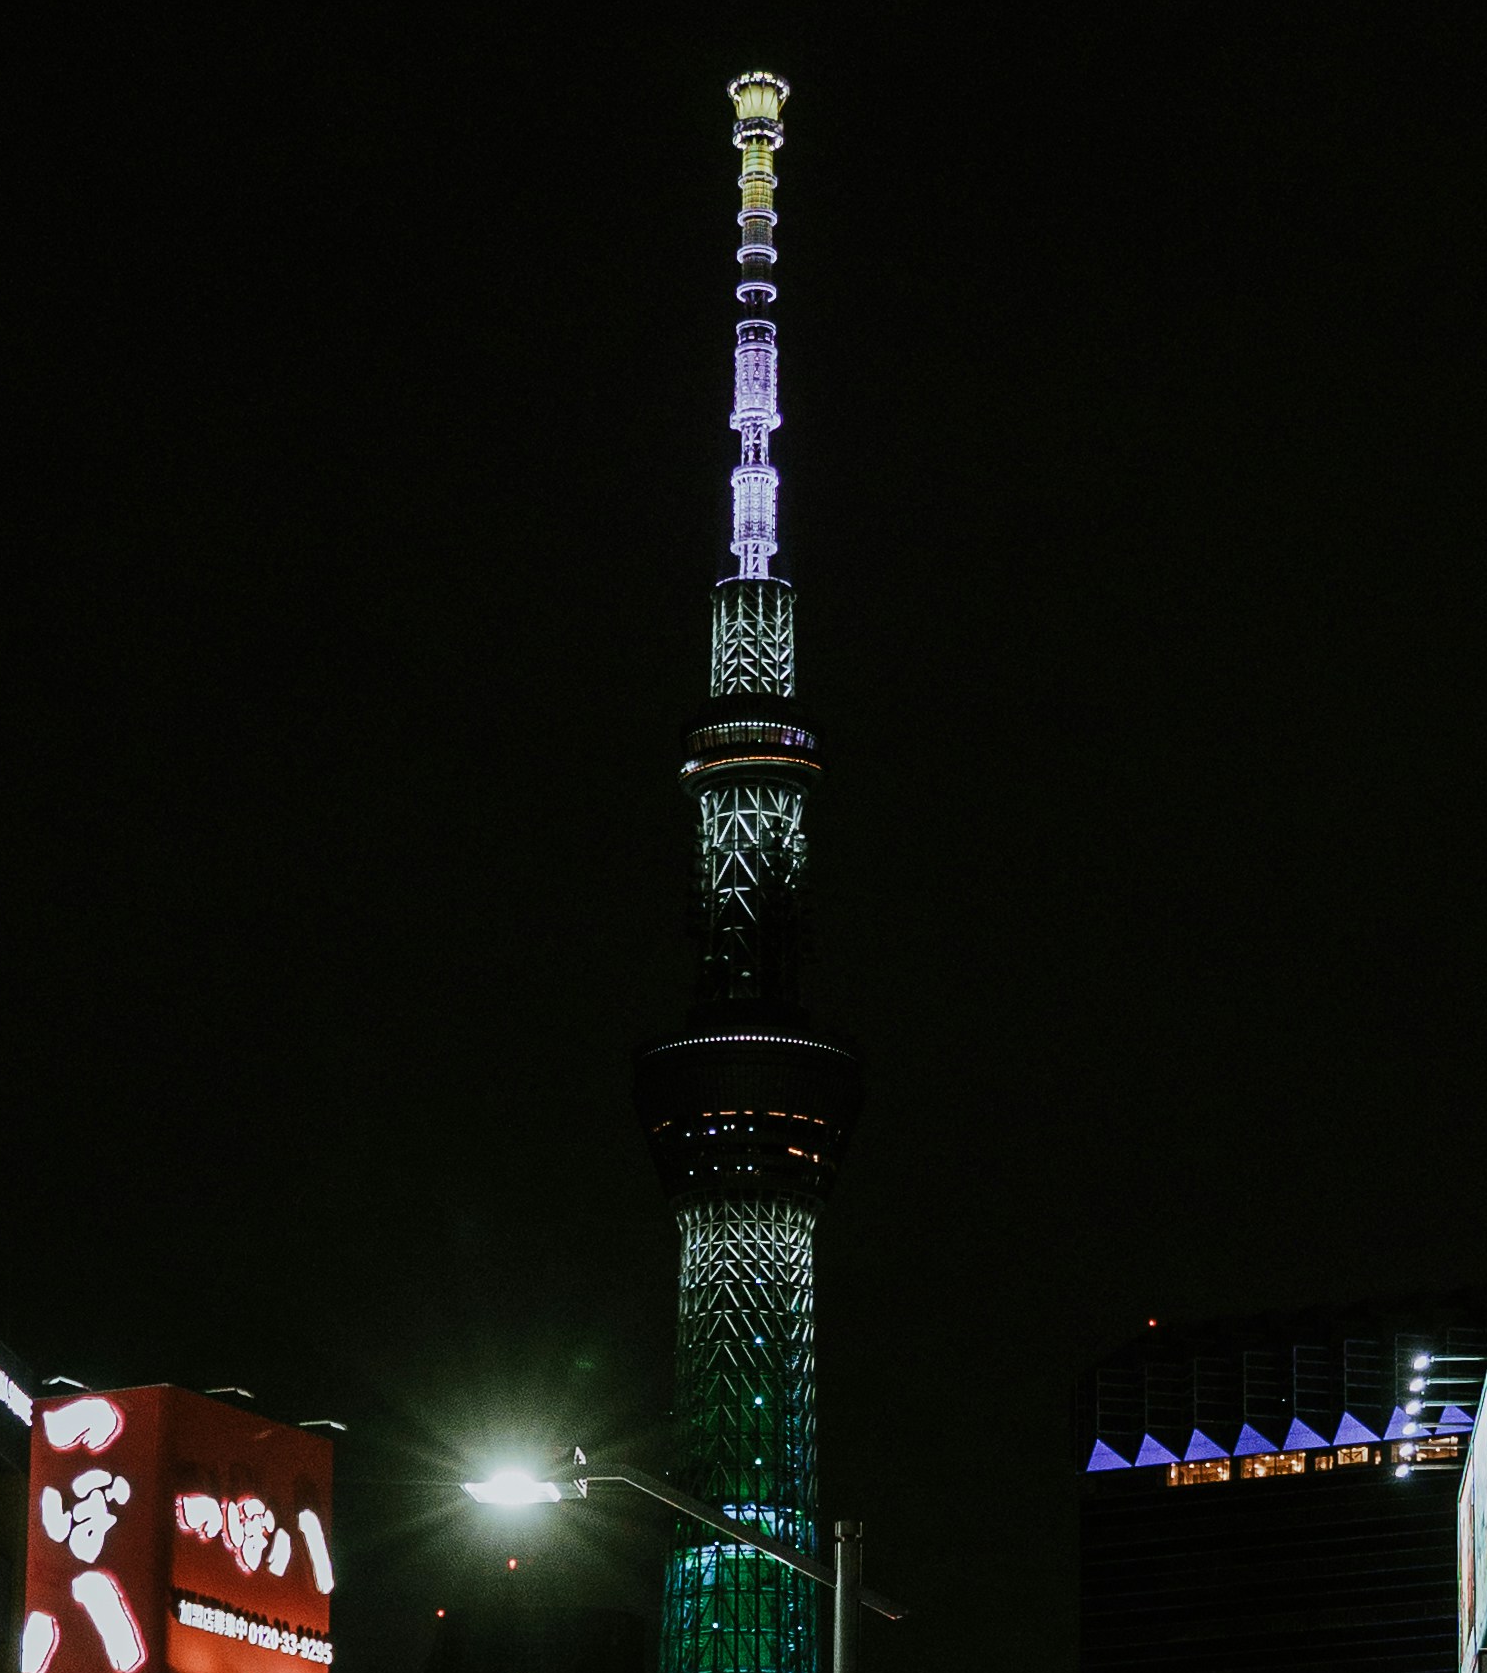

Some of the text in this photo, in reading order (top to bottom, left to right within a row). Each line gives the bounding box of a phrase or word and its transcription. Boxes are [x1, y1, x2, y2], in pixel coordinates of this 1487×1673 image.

[21, 1397, 147, 1673] つぼ八
[176, 1493, 335, 1595] つぼ八
